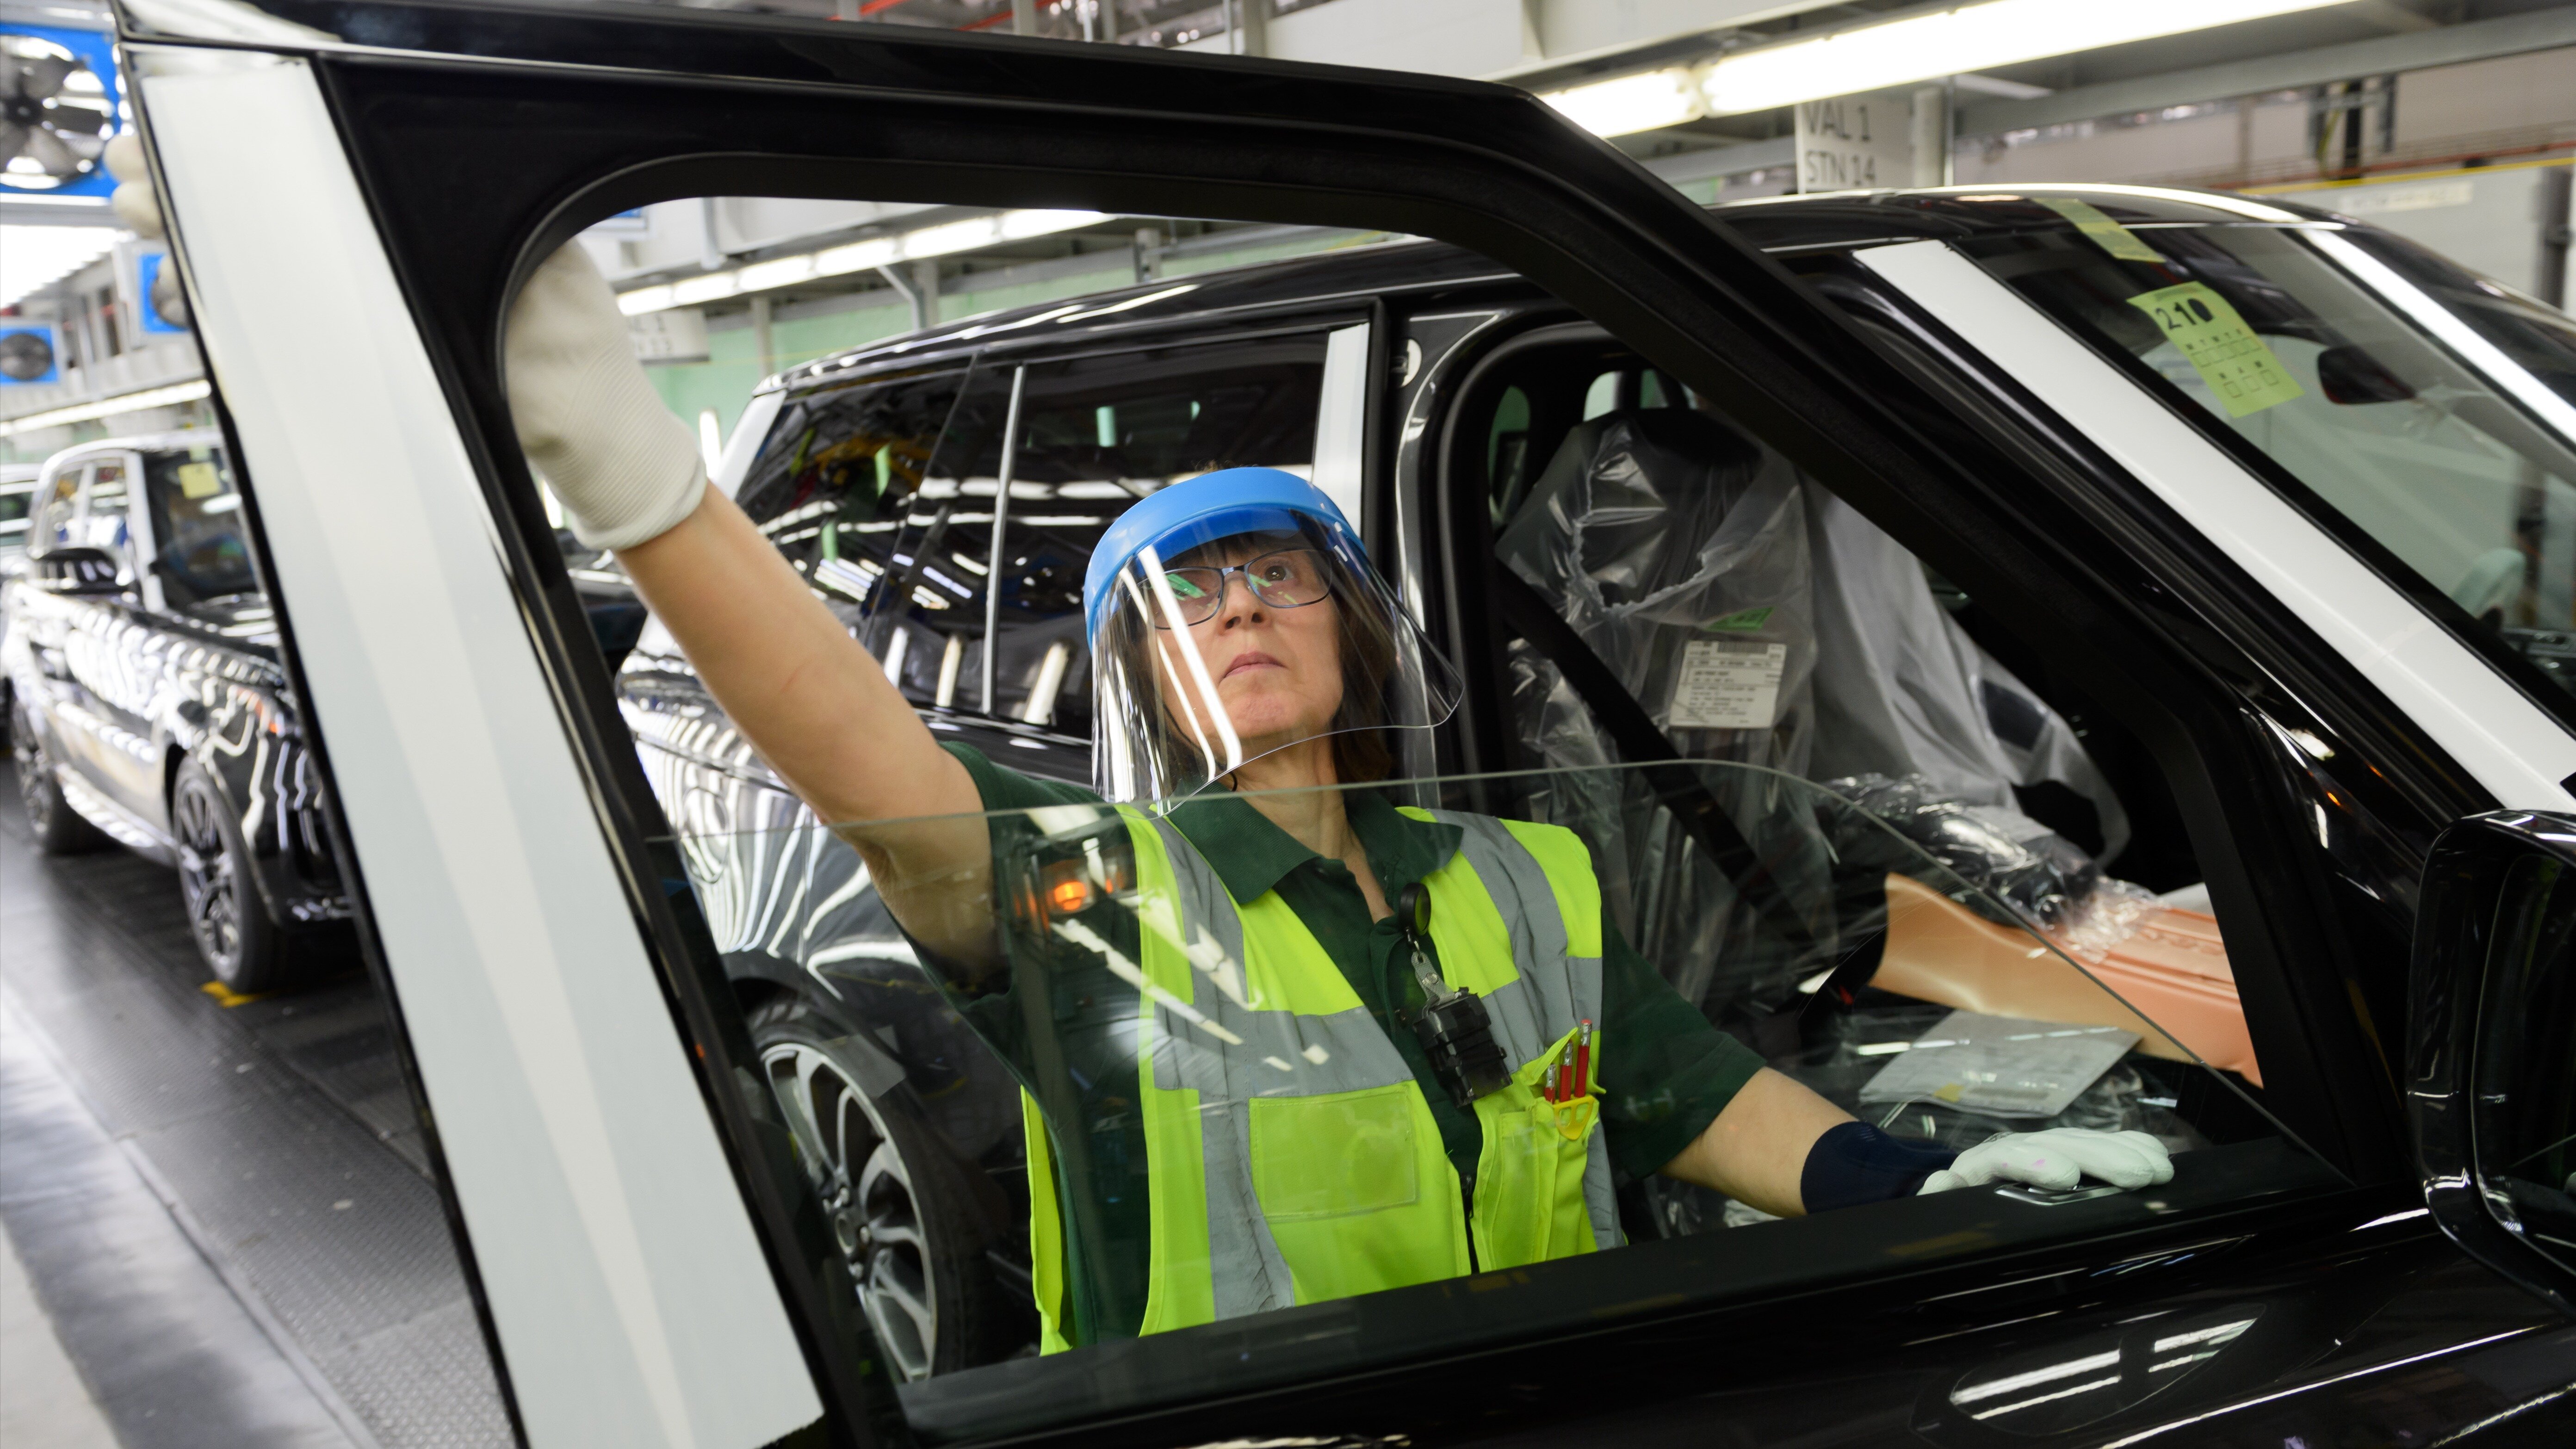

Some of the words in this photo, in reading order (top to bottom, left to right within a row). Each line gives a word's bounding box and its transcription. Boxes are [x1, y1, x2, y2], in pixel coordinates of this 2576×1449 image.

[1802, 100, 1852, 141] VAL
[1858, 103, 1871, 141] 1
[1806, 149, 1847, 184] STN
[1852, 154, 1876, 186] 14
[2155, 298, 2214, 330] 210
